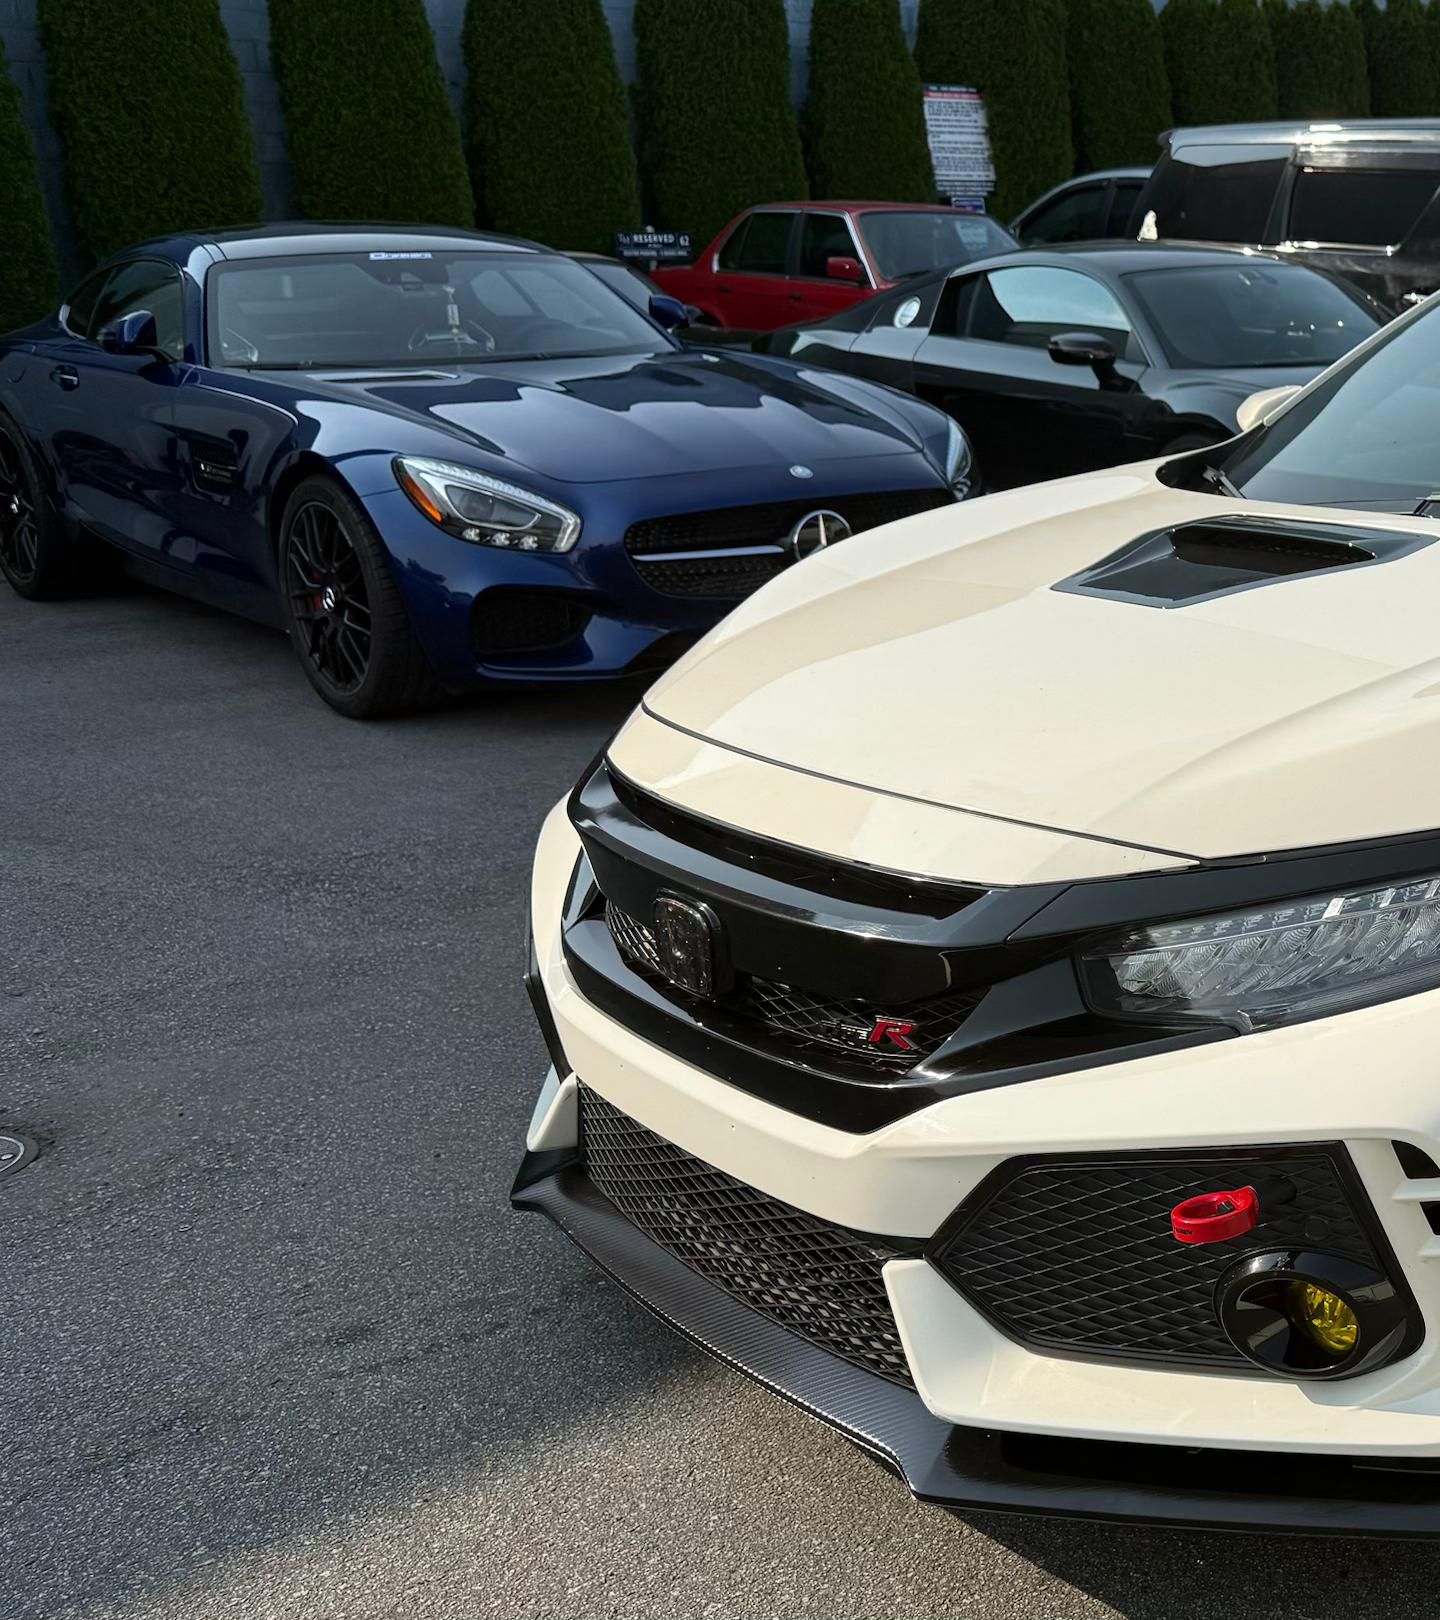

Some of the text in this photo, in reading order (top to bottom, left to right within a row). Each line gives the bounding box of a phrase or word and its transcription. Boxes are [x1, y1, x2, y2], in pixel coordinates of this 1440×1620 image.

[633, 233, 675, 244] RESERVED
[679, 234, 690, 247] 62
[867, 1015, 917, 1050] R
